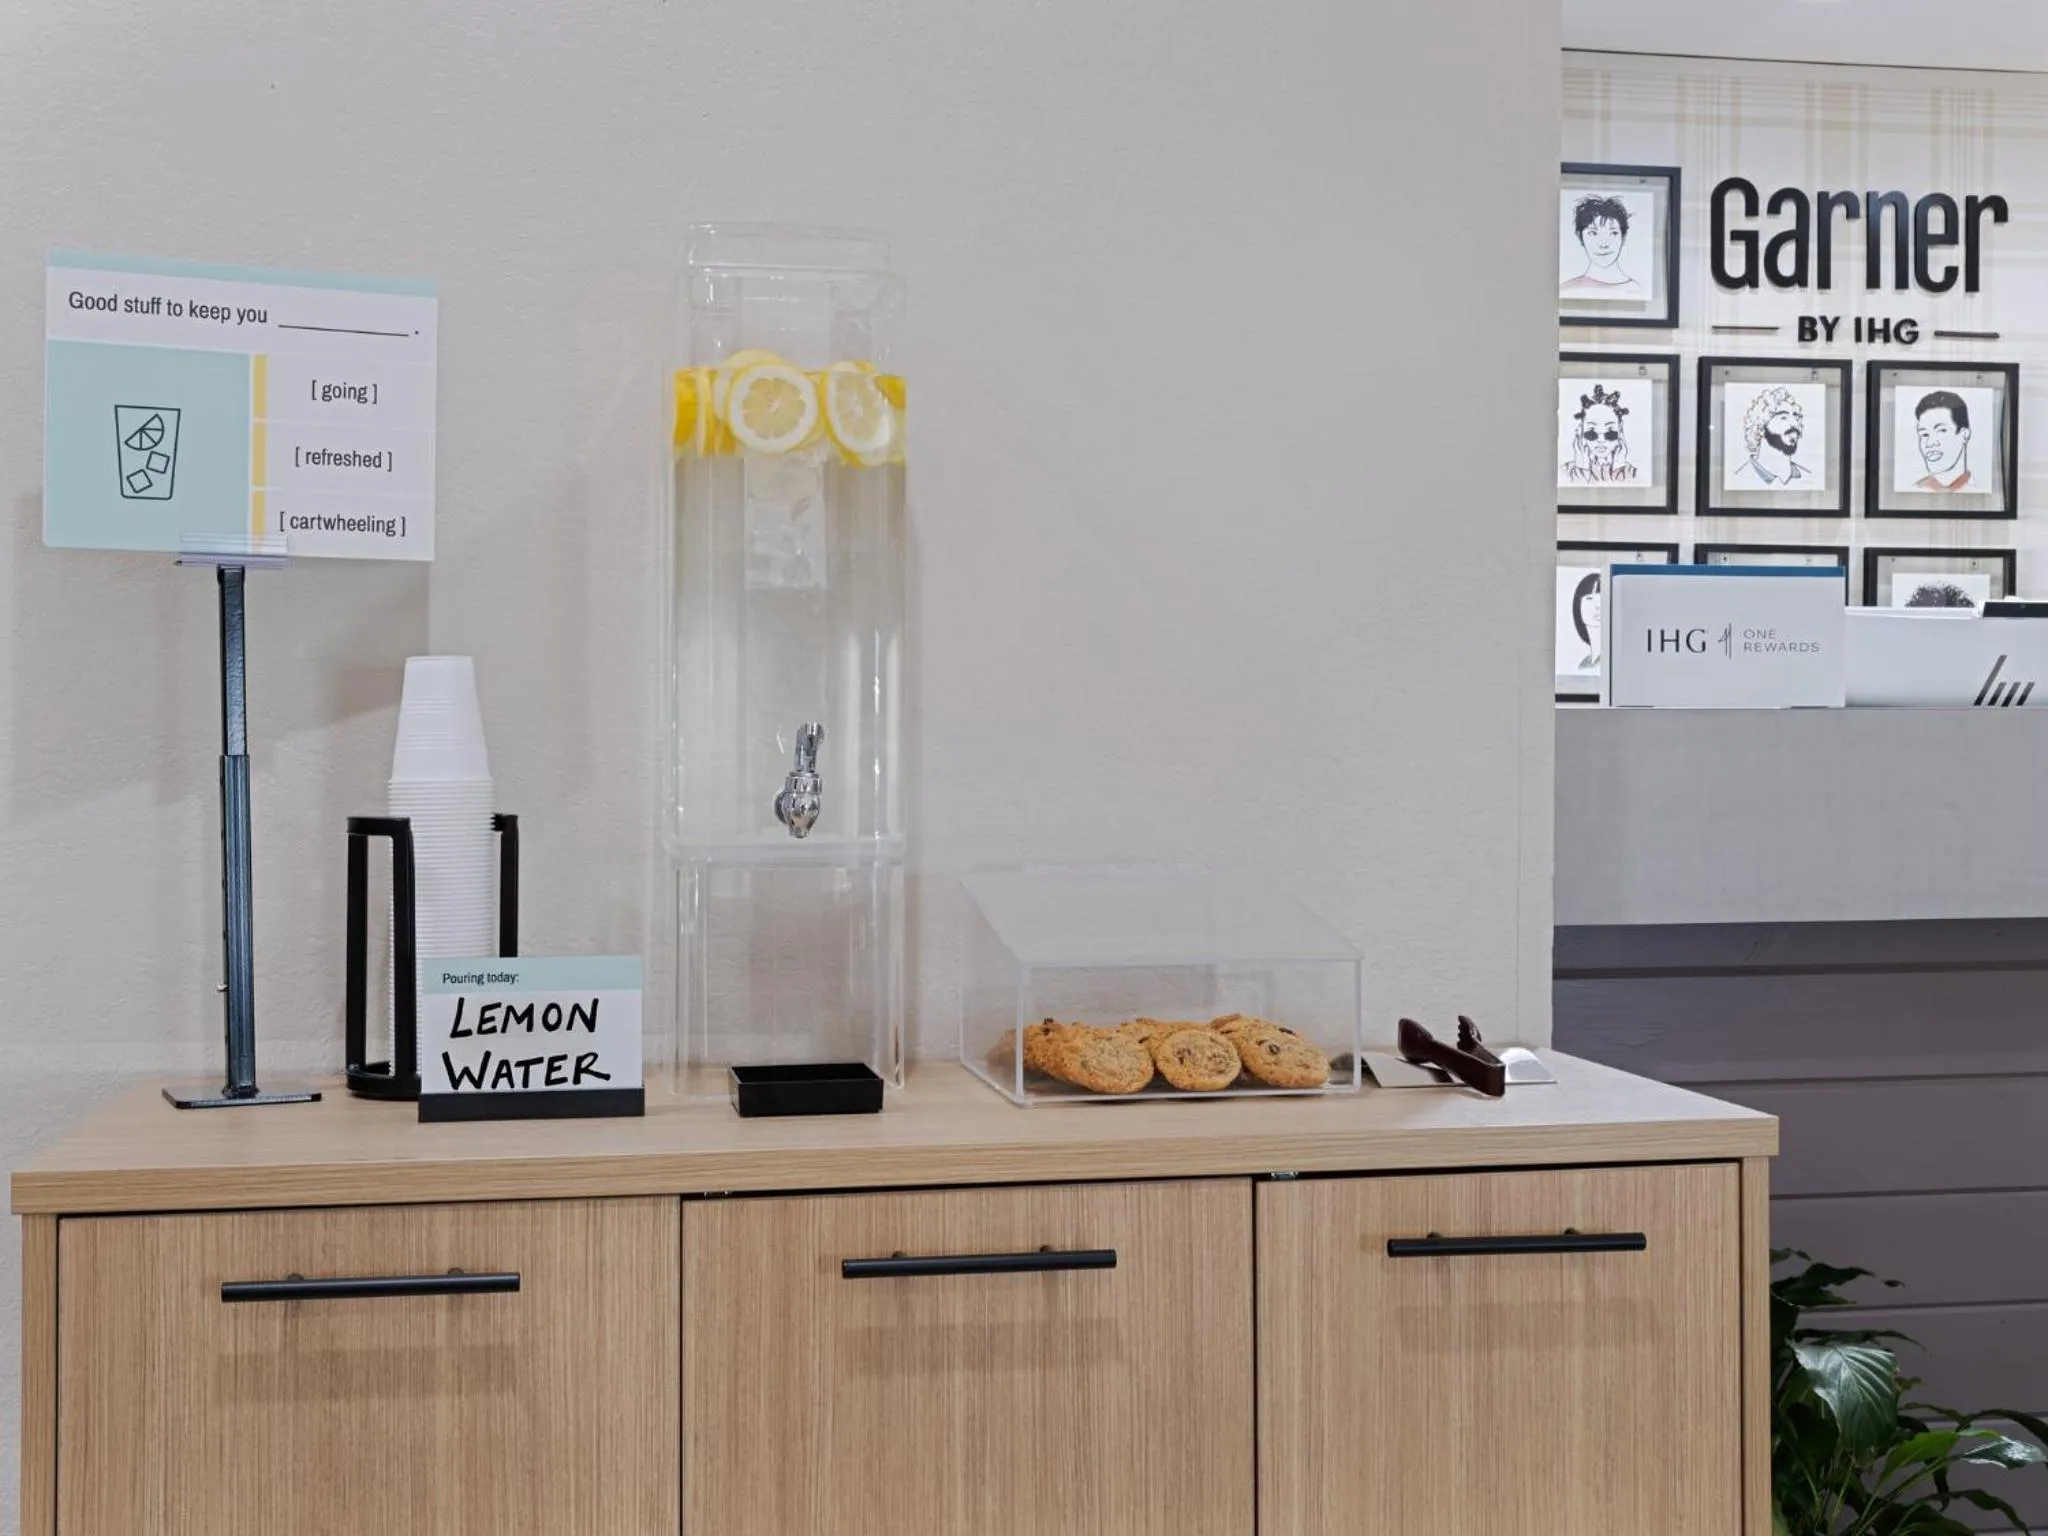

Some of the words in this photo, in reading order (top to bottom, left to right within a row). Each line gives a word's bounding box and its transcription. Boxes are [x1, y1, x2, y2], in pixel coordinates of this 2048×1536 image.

[1710, 176, 2009, 294] Garner
[68, 291, 118, 312] Good
[124, 296, 162, 316] stuff
[167, 299, 183, 317] to
[189, 300, 231, 323] keep
[237, 307, 268, 325] you
[1797, 315, 1841, 343] BY
[1854, 316, 1920, 345] IHG
[1647, 629, 1706, 653] IHG
[1743, 629, 1776, 639] ONE
[1743, 641, 1820, 653] REWARDS
[442, 972, 484, 986] Pouring
[487, 972, 519, 984] today:
[450, 997, 599, 1039] LEMON
[442, 1050, 611, 1090] WATER
